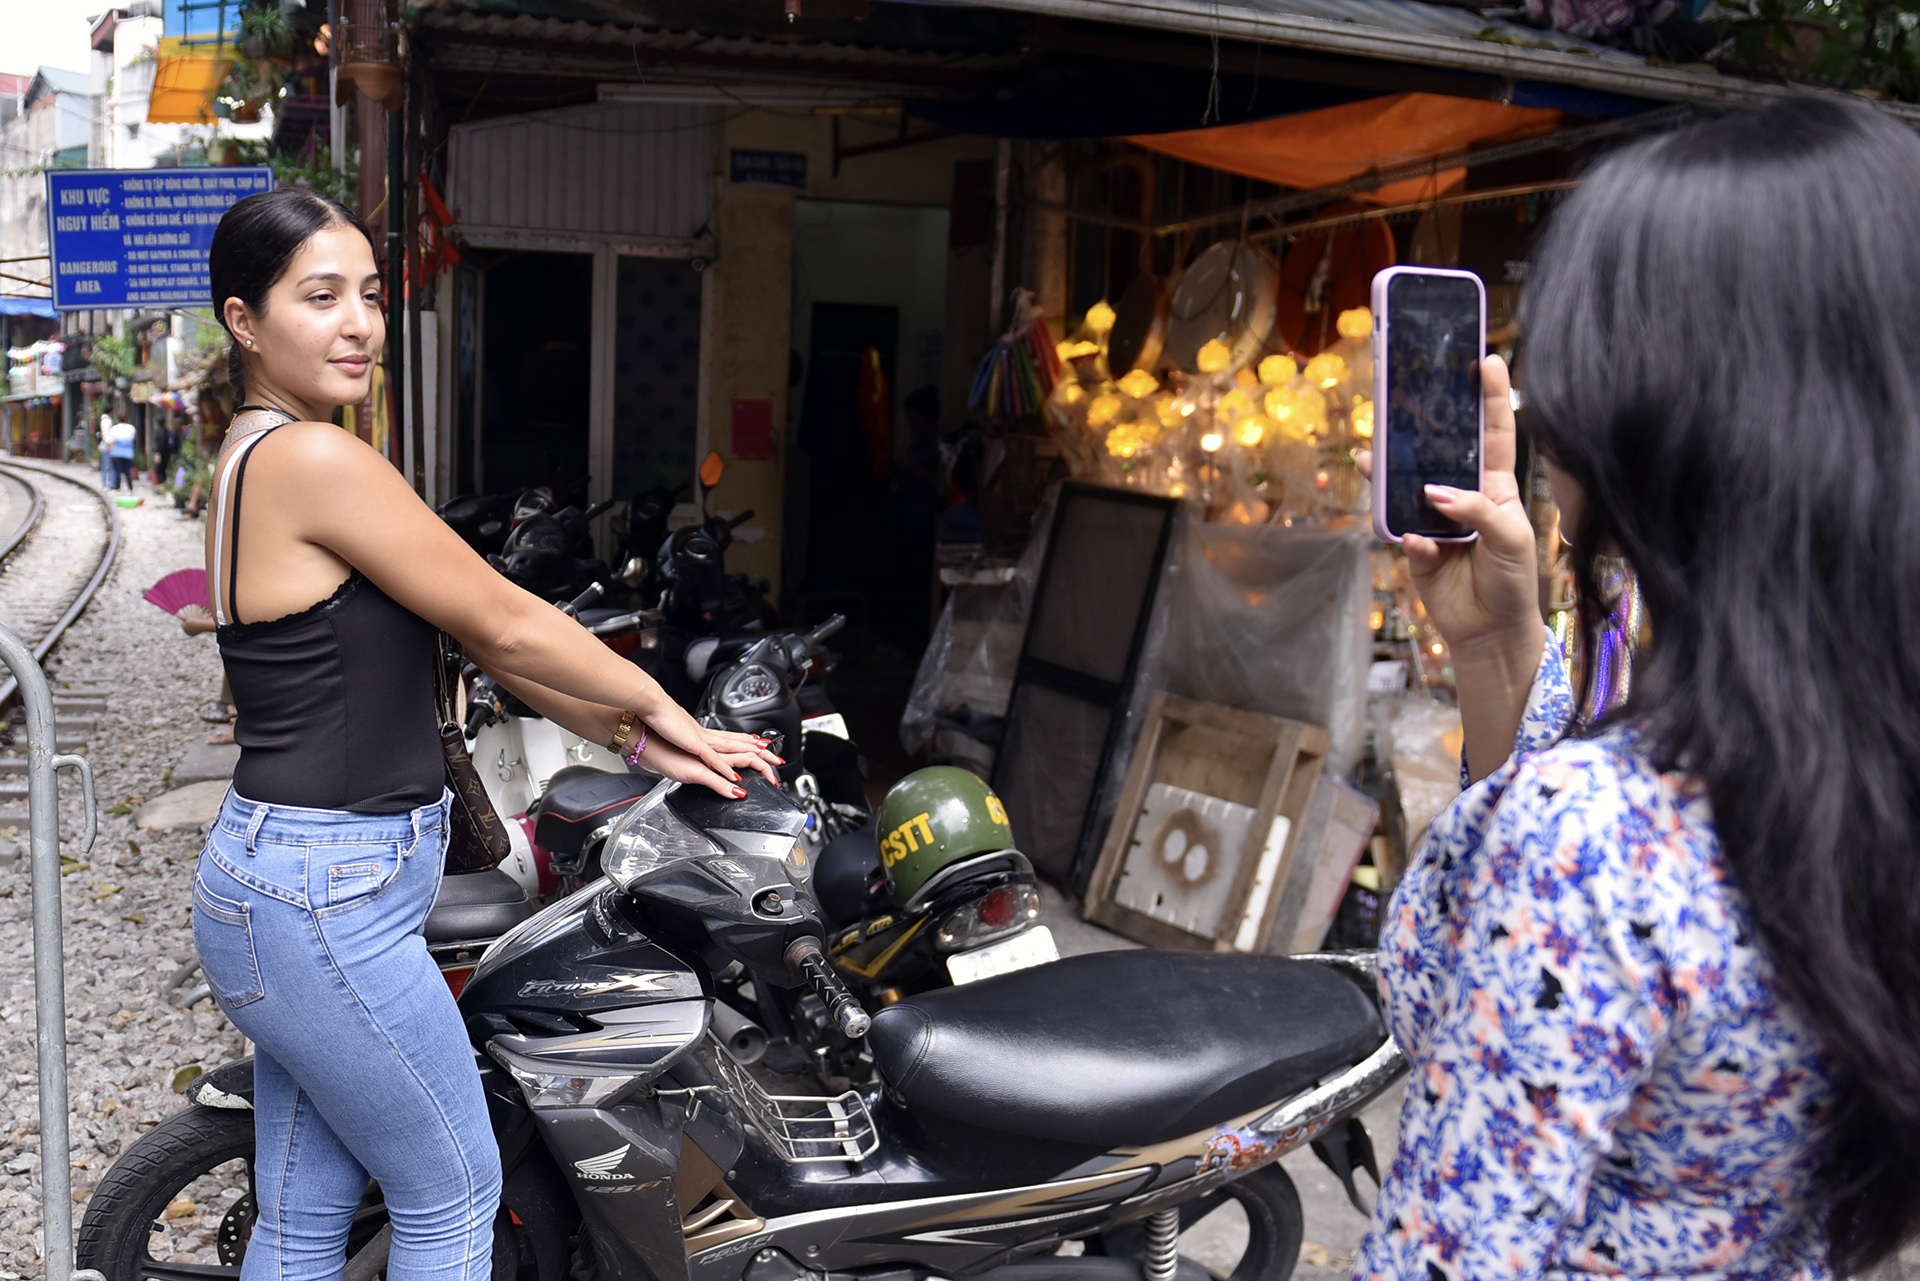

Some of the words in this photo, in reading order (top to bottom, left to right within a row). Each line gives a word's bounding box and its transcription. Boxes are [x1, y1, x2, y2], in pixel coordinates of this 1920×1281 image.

[60, 189, 85, 205] KHU
[86, 187, 110, 208] VỰC
[57, 215, 88, 232] NGUY
[90, 208, 120, 231] HIỂM
[60, 260, 118, 275] DANGEROUS
[75, 280, 102, 294] AREA
[881, 812, 935, 868] CSTT
[576, 1172, 635, 1180] HONDA
